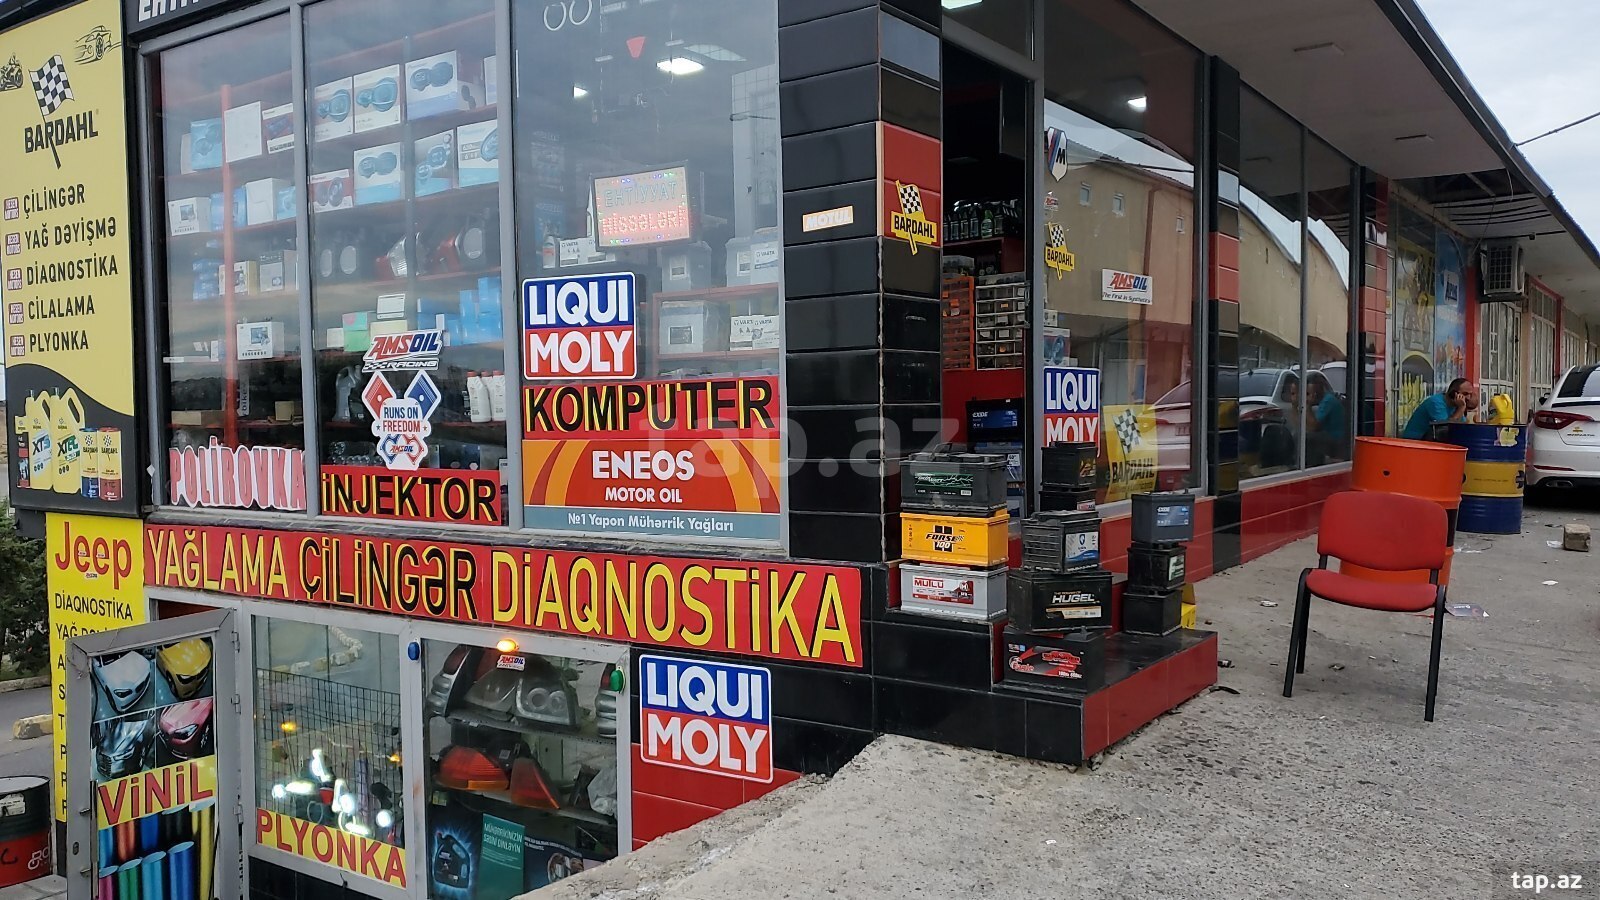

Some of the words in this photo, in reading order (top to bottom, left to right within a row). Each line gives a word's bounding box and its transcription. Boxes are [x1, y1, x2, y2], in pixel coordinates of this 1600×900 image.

[24, 110, 98, 153] BARDAHL
[23, 183, 85, 219] ÇİLİNGƏR
[25, 222, 49, 250] YAĞ
[54, 216, 117, 246] DƏYİŞMƏ
[806, 208, 850, 229] MOTUL
[894, 215, 935, 239] BARDAHL
[26, 252, 119, 286] DİAQNOSTİKA
[1047, 248, 1073, 267] BARDAHL
[1110, 272, 1148, 290] AMSOIL
[28, 294, 95, 320] CİLALAMA
[529, 279, 628, 327] LIQUI
[29, 330, 89, 352] PLYONKA
[368, 332, 439, 360] AMSOIL
[530, 330, 633, 374] MOLY
[387, 360, 437, 371] RACING
[525, 379, 775, 432] KOMPÜTER
[1046, 372, 1097, 412] LIQUI
[382, 420, 421, 433] FREEDOM
[384, 406, 406, 419] RUNS
[407, 406, 419, 419] ON
[390, 445, 414, 454] AMSOIL
[168, 436, 306, 509] POLİROVKA
[592, 450, 695, 481] ENEOS
[605, 487, 655, 502] MOTOR
[659, 488, 683, 503] OIL
[588, 513, 625, 529] Yapon
[628, 515, 685, 530] Mühərrik
[687, 517, 734, 533] Yağları
[55, 522, 131, 589] Jeep
[936, 541, 951, 549] 100
[147, 528, 290, 597] YAĞLAMA
[55, 590, 133, 621] DİAQNOSTİKA
[1052, 593, 1095, 604] HUGEL
[500, 656, 524, 665] AMSOIL
[646, 662, 763, 720] LIQUI
[647, 713, 768, 774] MOLY
[257, 809, 407, 888] PLYONKA
